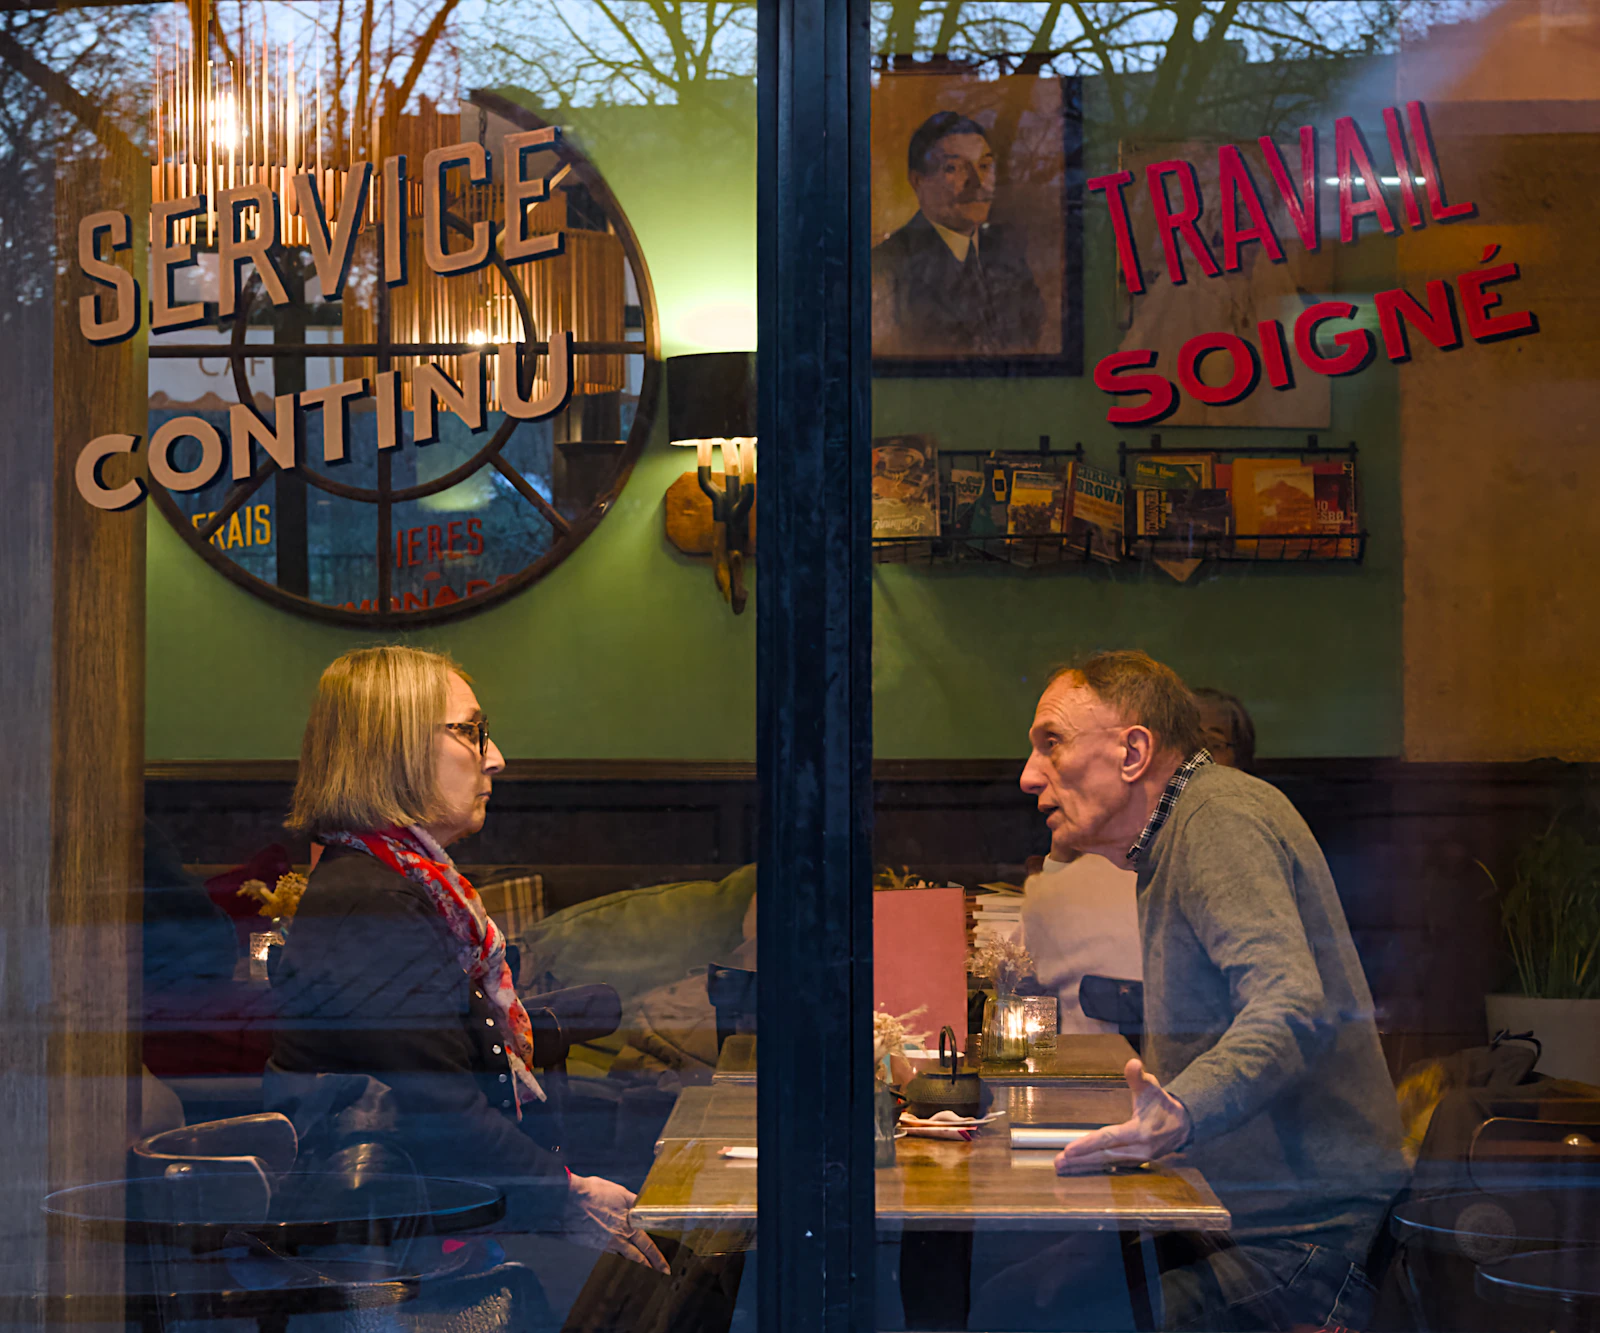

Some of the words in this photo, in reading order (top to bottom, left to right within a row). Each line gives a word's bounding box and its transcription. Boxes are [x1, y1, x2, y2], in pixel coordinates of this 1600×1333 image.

[78, 127, 564, 344] SERVICE
[1087, 101, 1477, 294] TRAVAIL
[75, 332, 574, 511] CONTINU
[1093, 243, 1539, 428] SOIGNÉ
